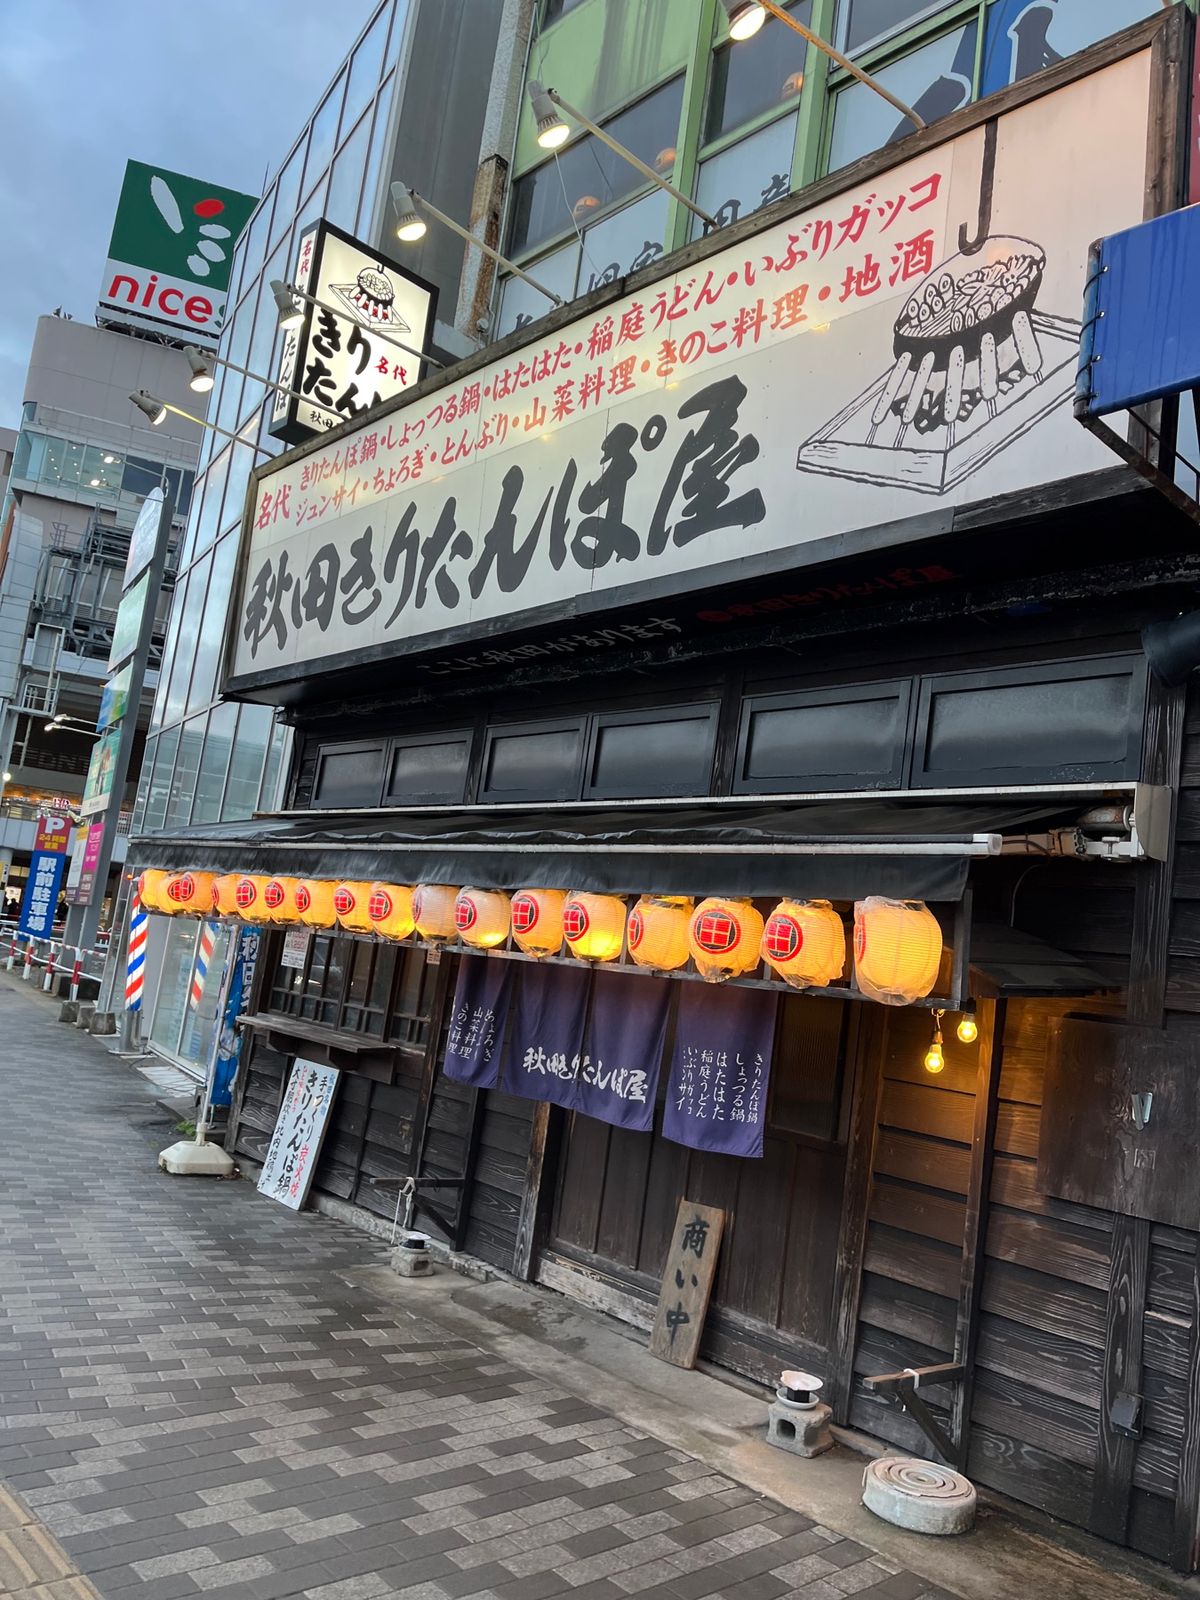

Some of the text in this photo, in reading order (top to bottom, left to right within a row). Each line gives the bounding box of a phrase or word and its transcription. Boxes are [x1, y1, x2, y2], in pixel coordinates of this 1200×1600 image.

[300, 240, 312, 276] 名代
[375, 356, 407, 385] 名代
[244, 374, 767, 660] 秋田きりたんぽ屋
[254, 483, 292, 530] 名代
[416, 618, 682, 674] ここに秋田があります
[45, 817, 65, 834] P
[696, 1049, 714, 1119] 稲庭うどん
[712, 1051, 728, 1121] はたはた
[666, 1214, 710, 1346] 商い中
